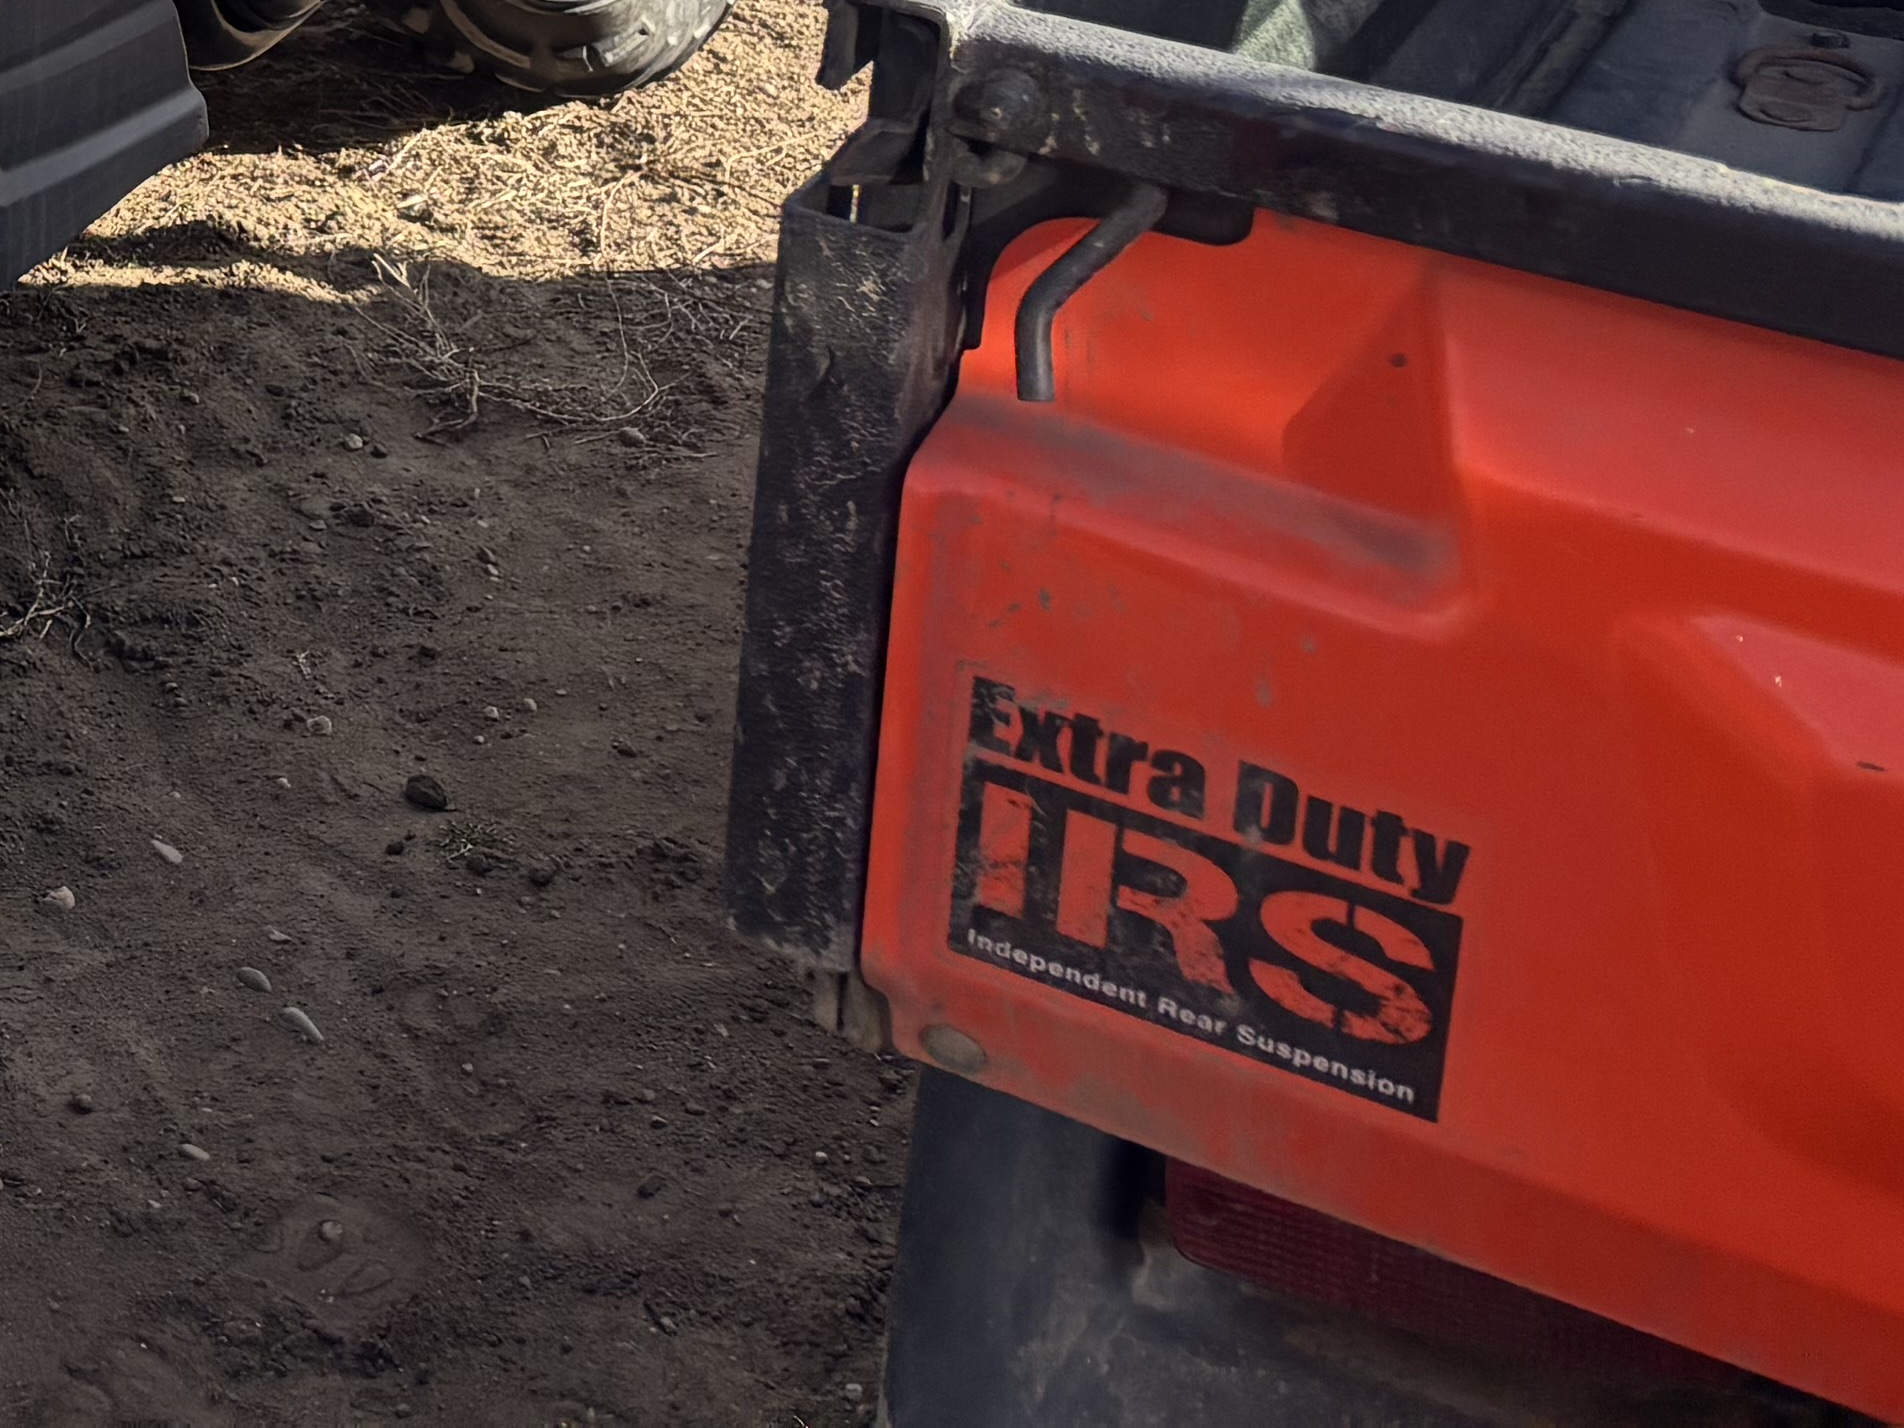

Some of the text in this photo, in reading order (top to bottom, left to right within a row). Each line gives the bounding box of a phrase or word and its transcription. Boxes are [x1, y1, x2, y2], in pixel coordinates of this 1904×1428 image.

[972, 675, 1471, 906] Extra Duty
[966, 929, 1417, 1104] Independent Rear Suspension
[978, 779, 1436, 1046] IRS
